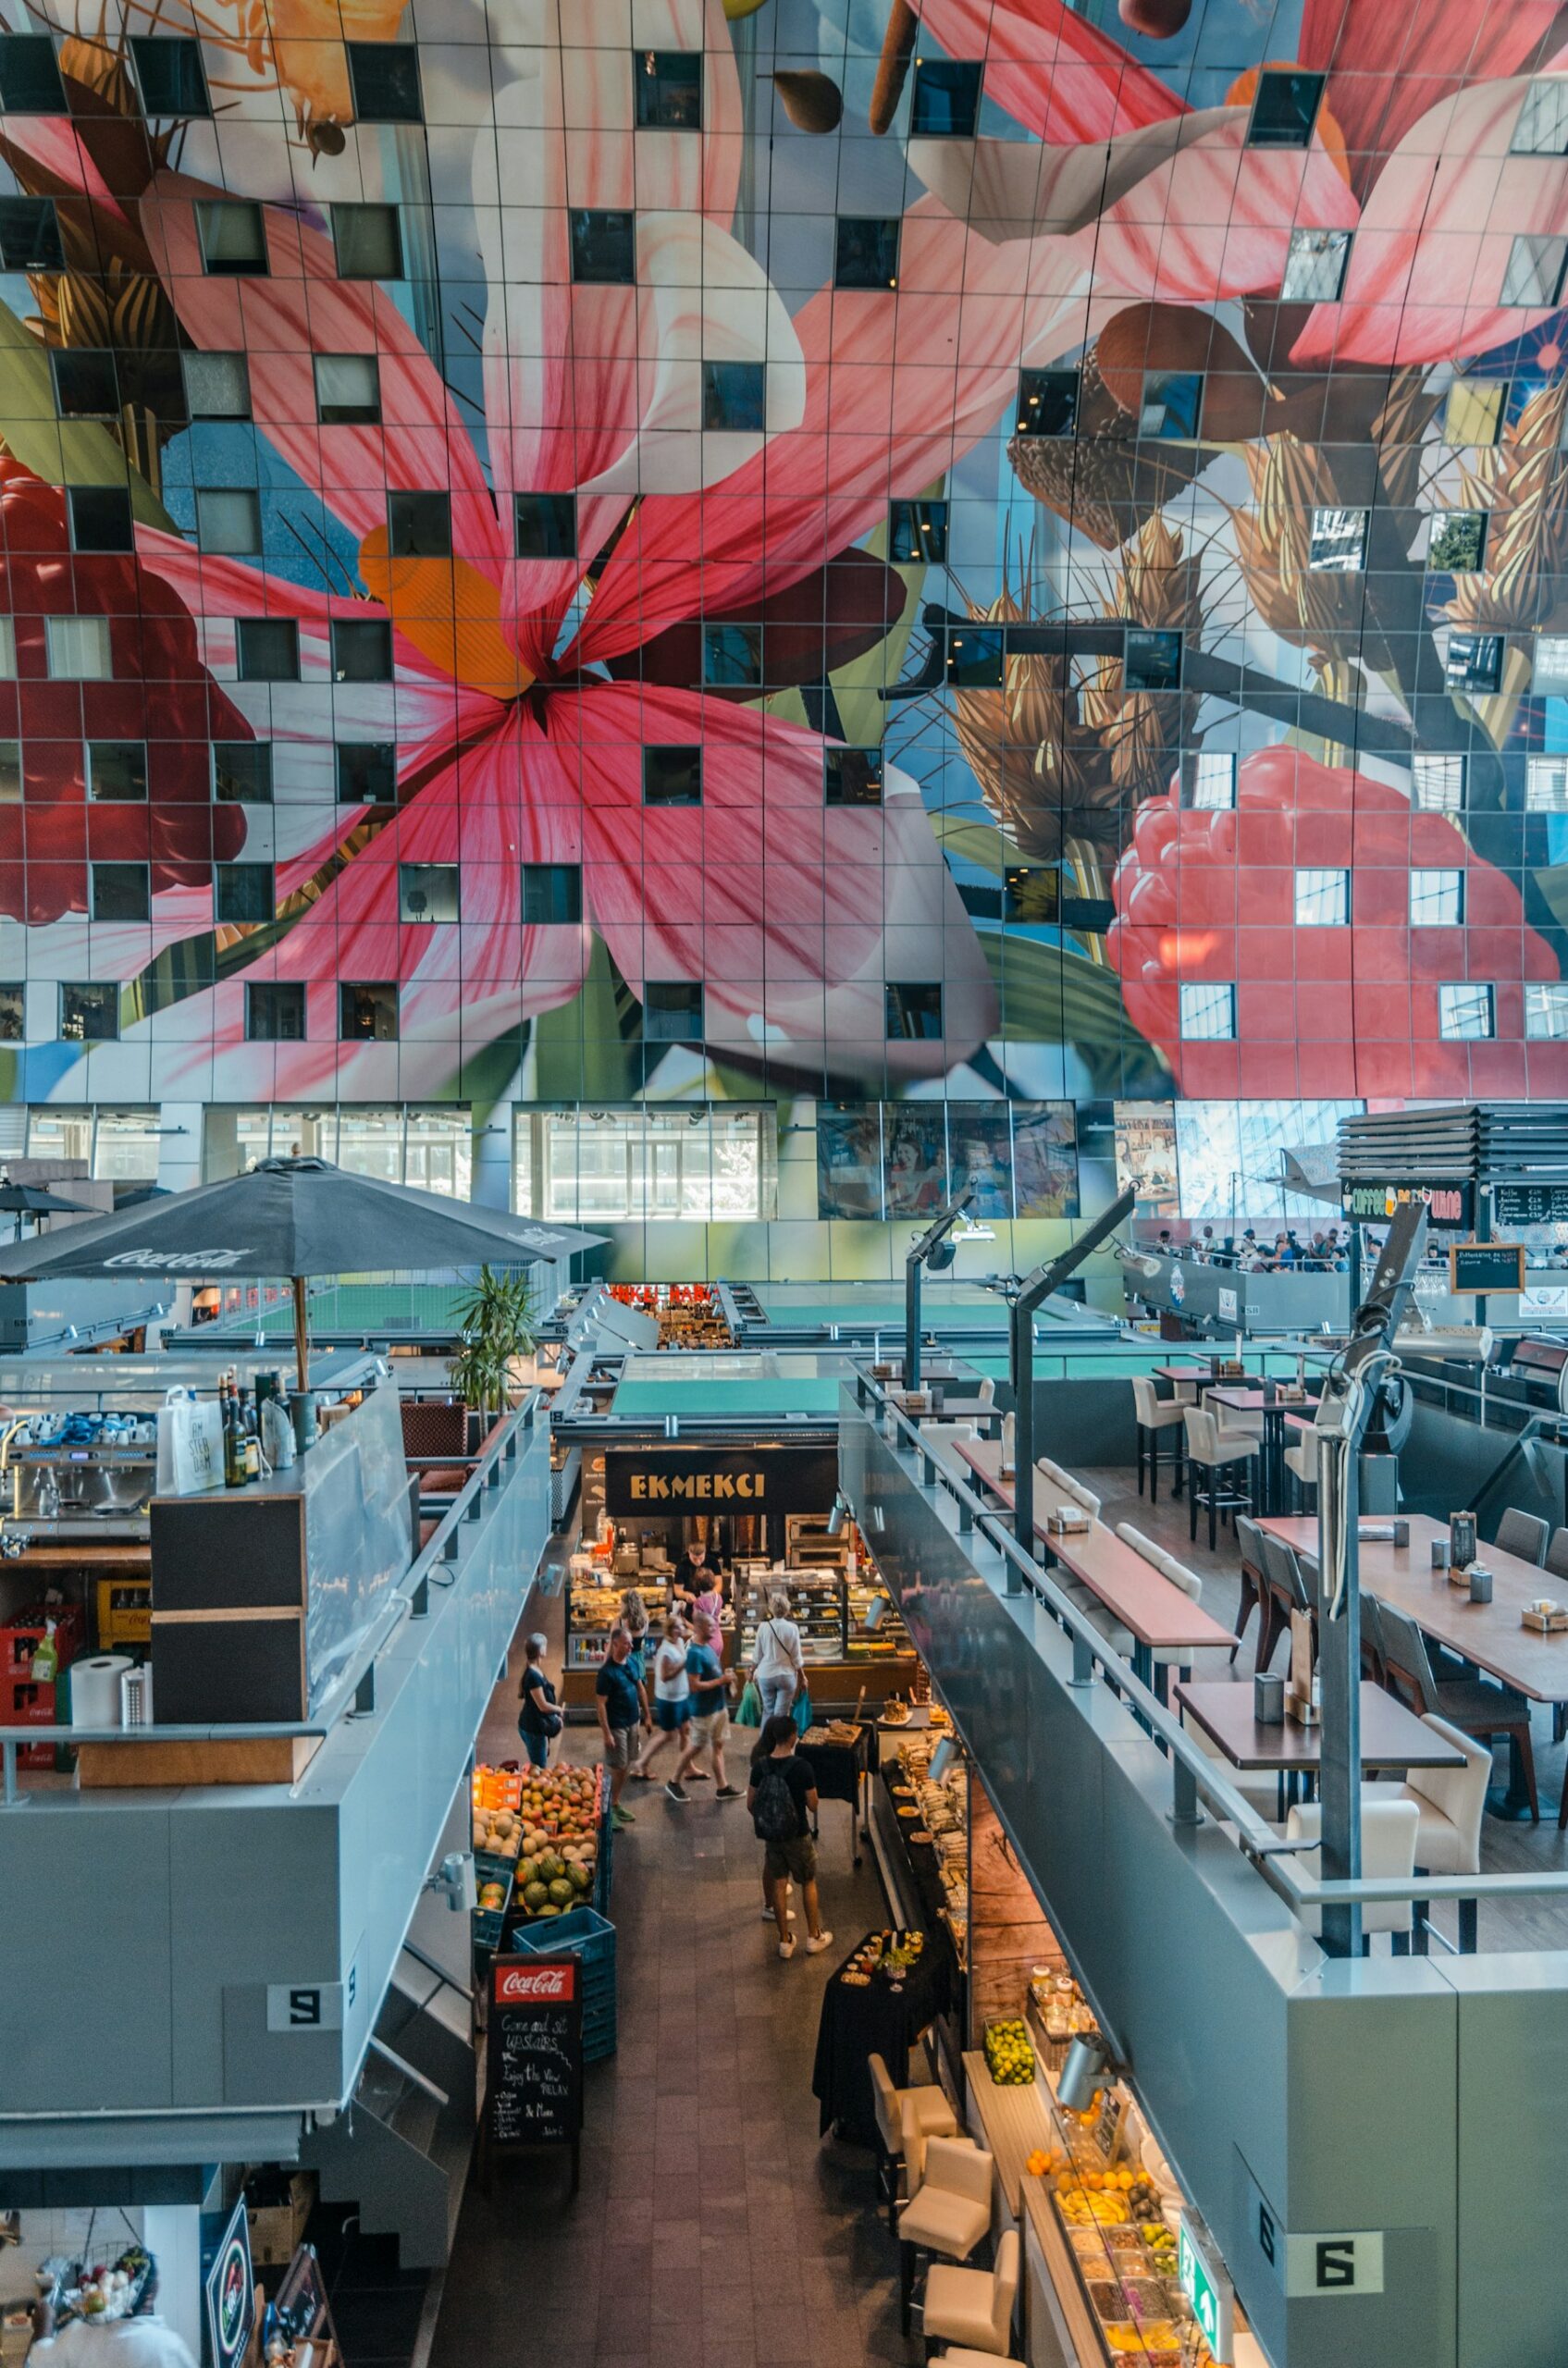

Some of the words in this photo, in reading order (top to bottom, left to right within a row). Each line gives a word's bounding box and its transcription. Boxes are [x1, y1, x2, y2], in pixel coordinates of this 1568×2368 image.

[631, 1474, 765, 1498] EKMEKCI
[290, 1990, 320, 2024] 9
[1315, 2240, 1354, 2288] 6
